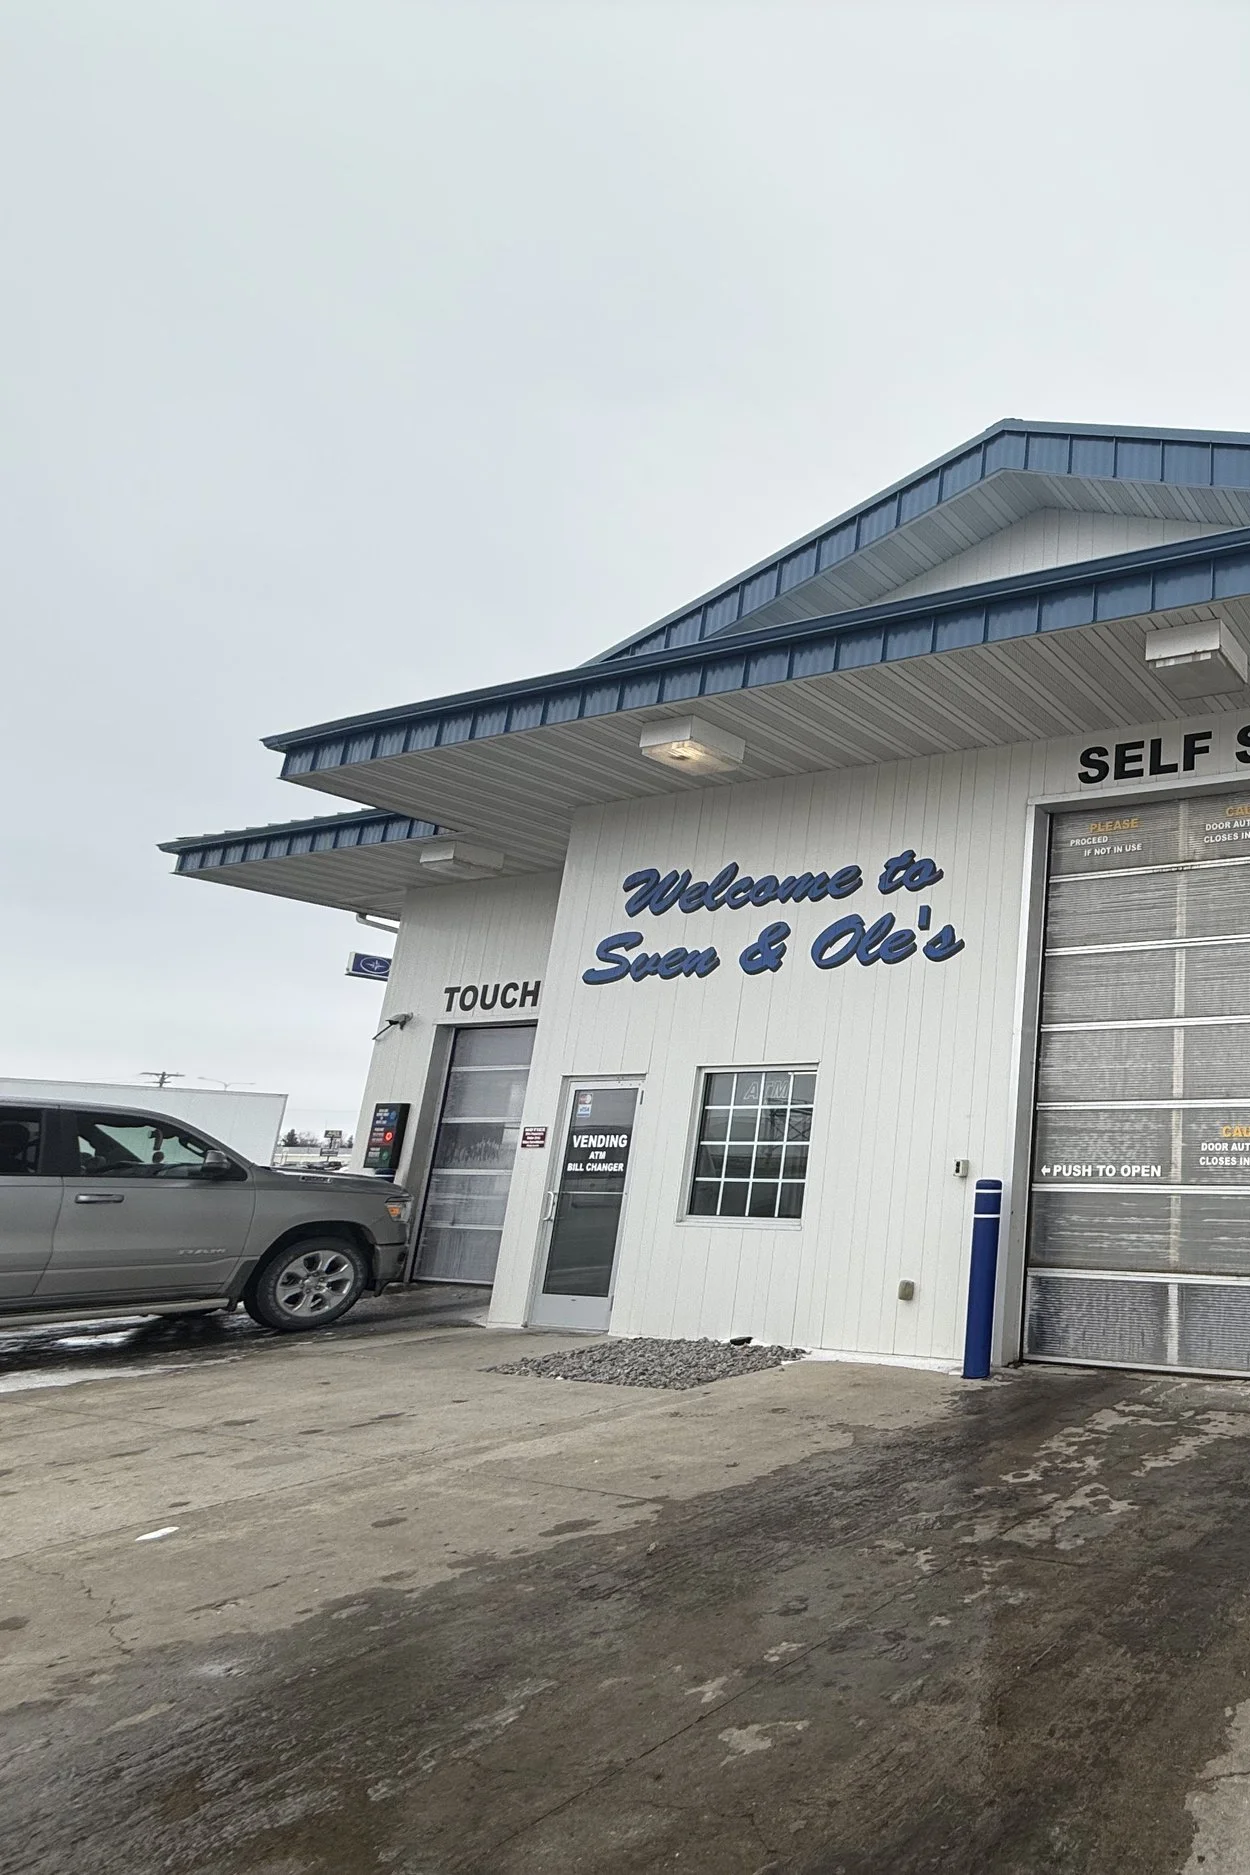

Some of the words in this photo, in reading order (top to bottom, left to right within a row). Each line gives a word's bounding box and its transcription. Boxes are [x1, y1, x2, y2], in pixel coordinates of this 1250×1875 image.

[1078, 731, 1213, 784] SELF
[1088, 818, 1139, 833] PLEASE
[1205, 822, 1231, 831] DOOR
[1070, 835, 1108, 846] PROCEED
[1204, 833, 1239, 843] CLOSES
[1084, 849, 1092, 857] IF
[1094, 847, 1112, 856] NOT
[1114, 845, 1123, 853] IN
[1125, 843, 1142, 852] USE
[622, 861, 863, 918] Welcome
[877, 849, 944, 895] to
[582, 931, 721, 986] Sven
[738, 920, 792, 976] &
[810, 904, 965, 971] Ole's
[444, 980, 541, 1012] TOUCH
[573, 1134, 628, 1148] VENDING
[1201, 1142, 1229, 1151] DOOR
[588, 1151, 606, 1160] ATM
[1199, 1157, 1237, 1166] CLOSES
[1240, 1157, 1250, 1166] IN
[567, 1162, 584, 1172] BILL
[586, 1162, 624, 1172] CHANGER
[1052, 1164, 1092, 1177] PUSH
[1096, 1165, 1116, 1177] TO
[1120, 1165, 1162, 1177] OPEN
